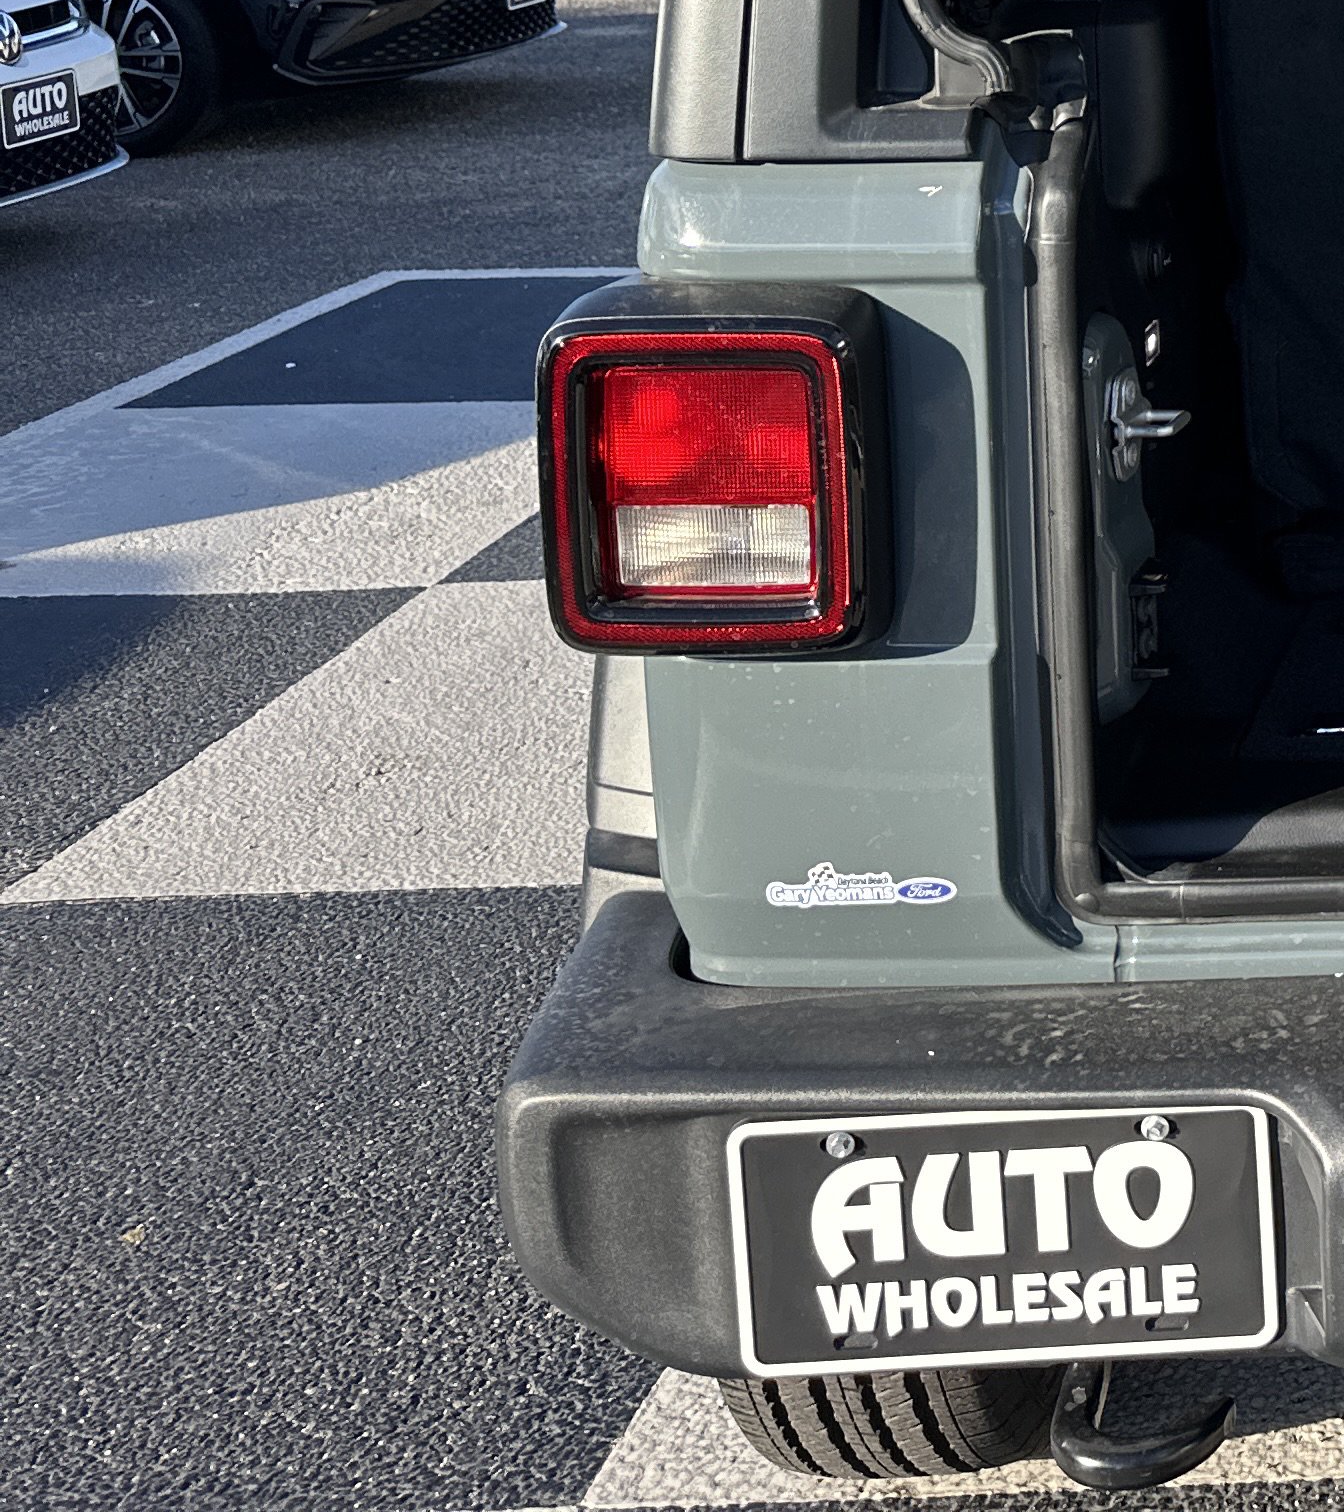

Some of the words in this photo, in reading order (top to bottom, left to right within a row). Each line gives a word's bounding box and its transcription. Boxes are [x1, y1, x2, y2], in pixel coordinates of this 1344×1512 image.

[13, 81, 67, 122] AUTO
[14, 110, 70, 137] WHOLESALE
[771, 886, 812, 904] Gary
[812, 885, 895, 901] Yeomans
[907, 884, 942, 897] Ford
[811, 1140, 1195, 1278] AUTO
[815, 1263, 1200, 1338] WHOLESALE
